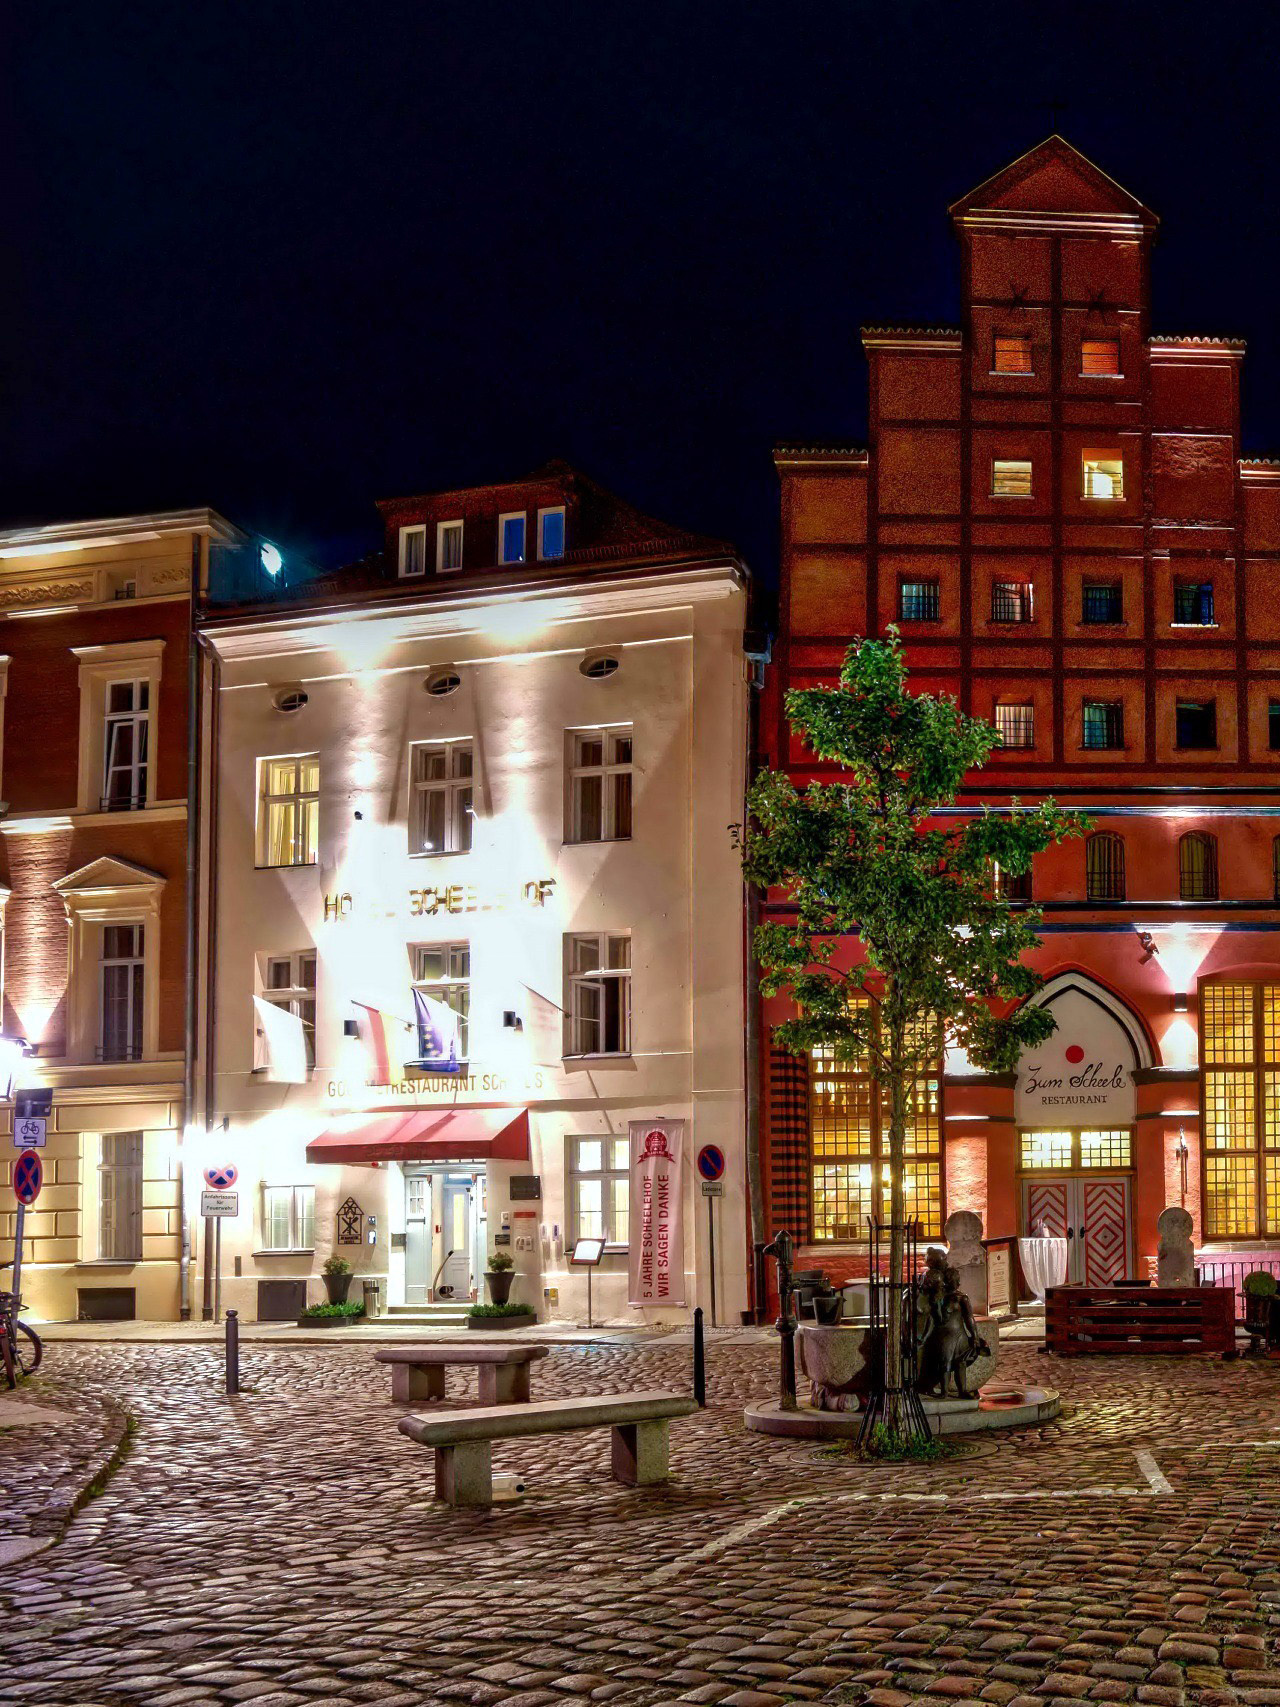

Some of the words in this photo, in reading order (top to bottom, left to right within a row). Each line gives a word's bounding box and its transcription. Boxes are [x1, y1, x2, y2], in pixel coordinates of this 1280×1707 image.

[1025, 1065, 1063, 1094] Zum
[1069, 1062, 1127, 1089] Scheele
[1041, 1094, 1108, 1105] RESTAURANT
[643, 1175, 653, 1247] SCHEELEHOF
[658, 1174, 670, 1218] DANKE
[658, 1224, 669, 1268] SAGEN
[643, 1251, 653, 1287] JAHRE
[658, 1272, 670, 1298] WIR
[643, 1289, 653, 1298] 5
